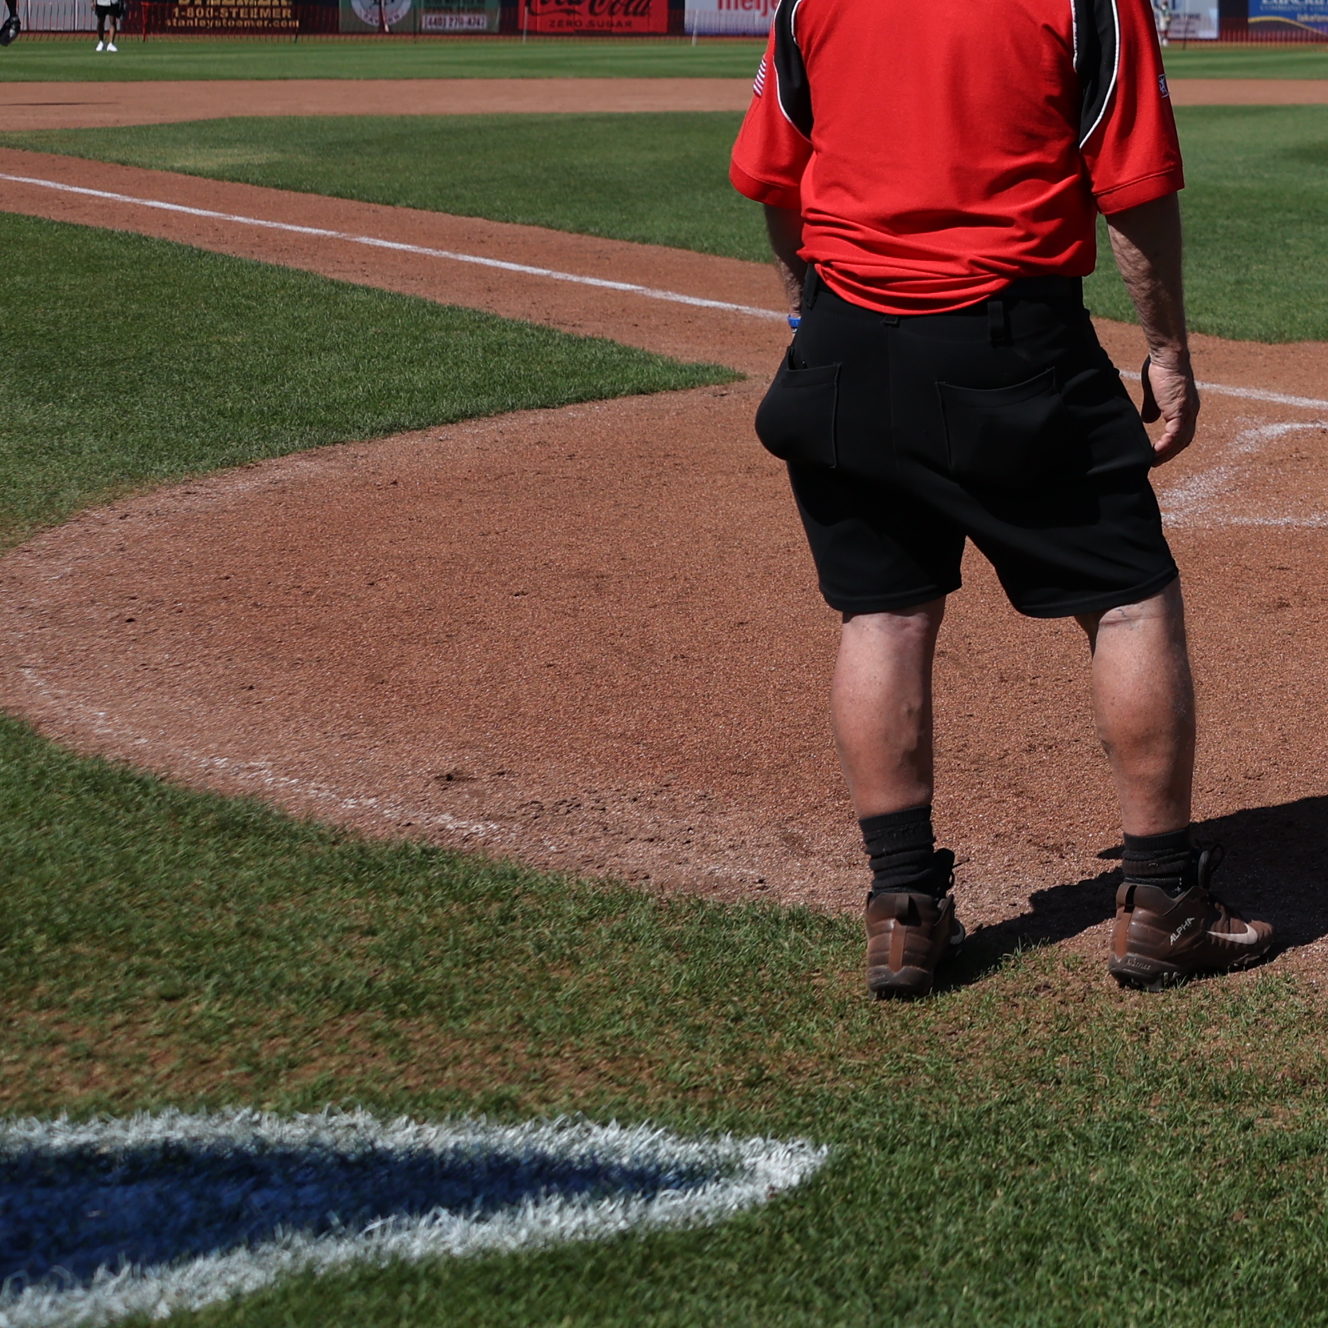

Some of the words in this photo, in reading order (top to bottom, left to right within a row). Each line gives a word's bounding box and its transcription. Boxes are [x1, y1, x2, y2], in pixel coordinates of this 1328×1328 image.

[172, 7, 292, 19] 1-800-STEEMER
[166, 18, 299, 28] stanleysteemer.com
[550, 19, 583, 28] ZERO
[588, 19, 632, 28] SUGAR
[1169, 917, 1196, 946] ALPHA
